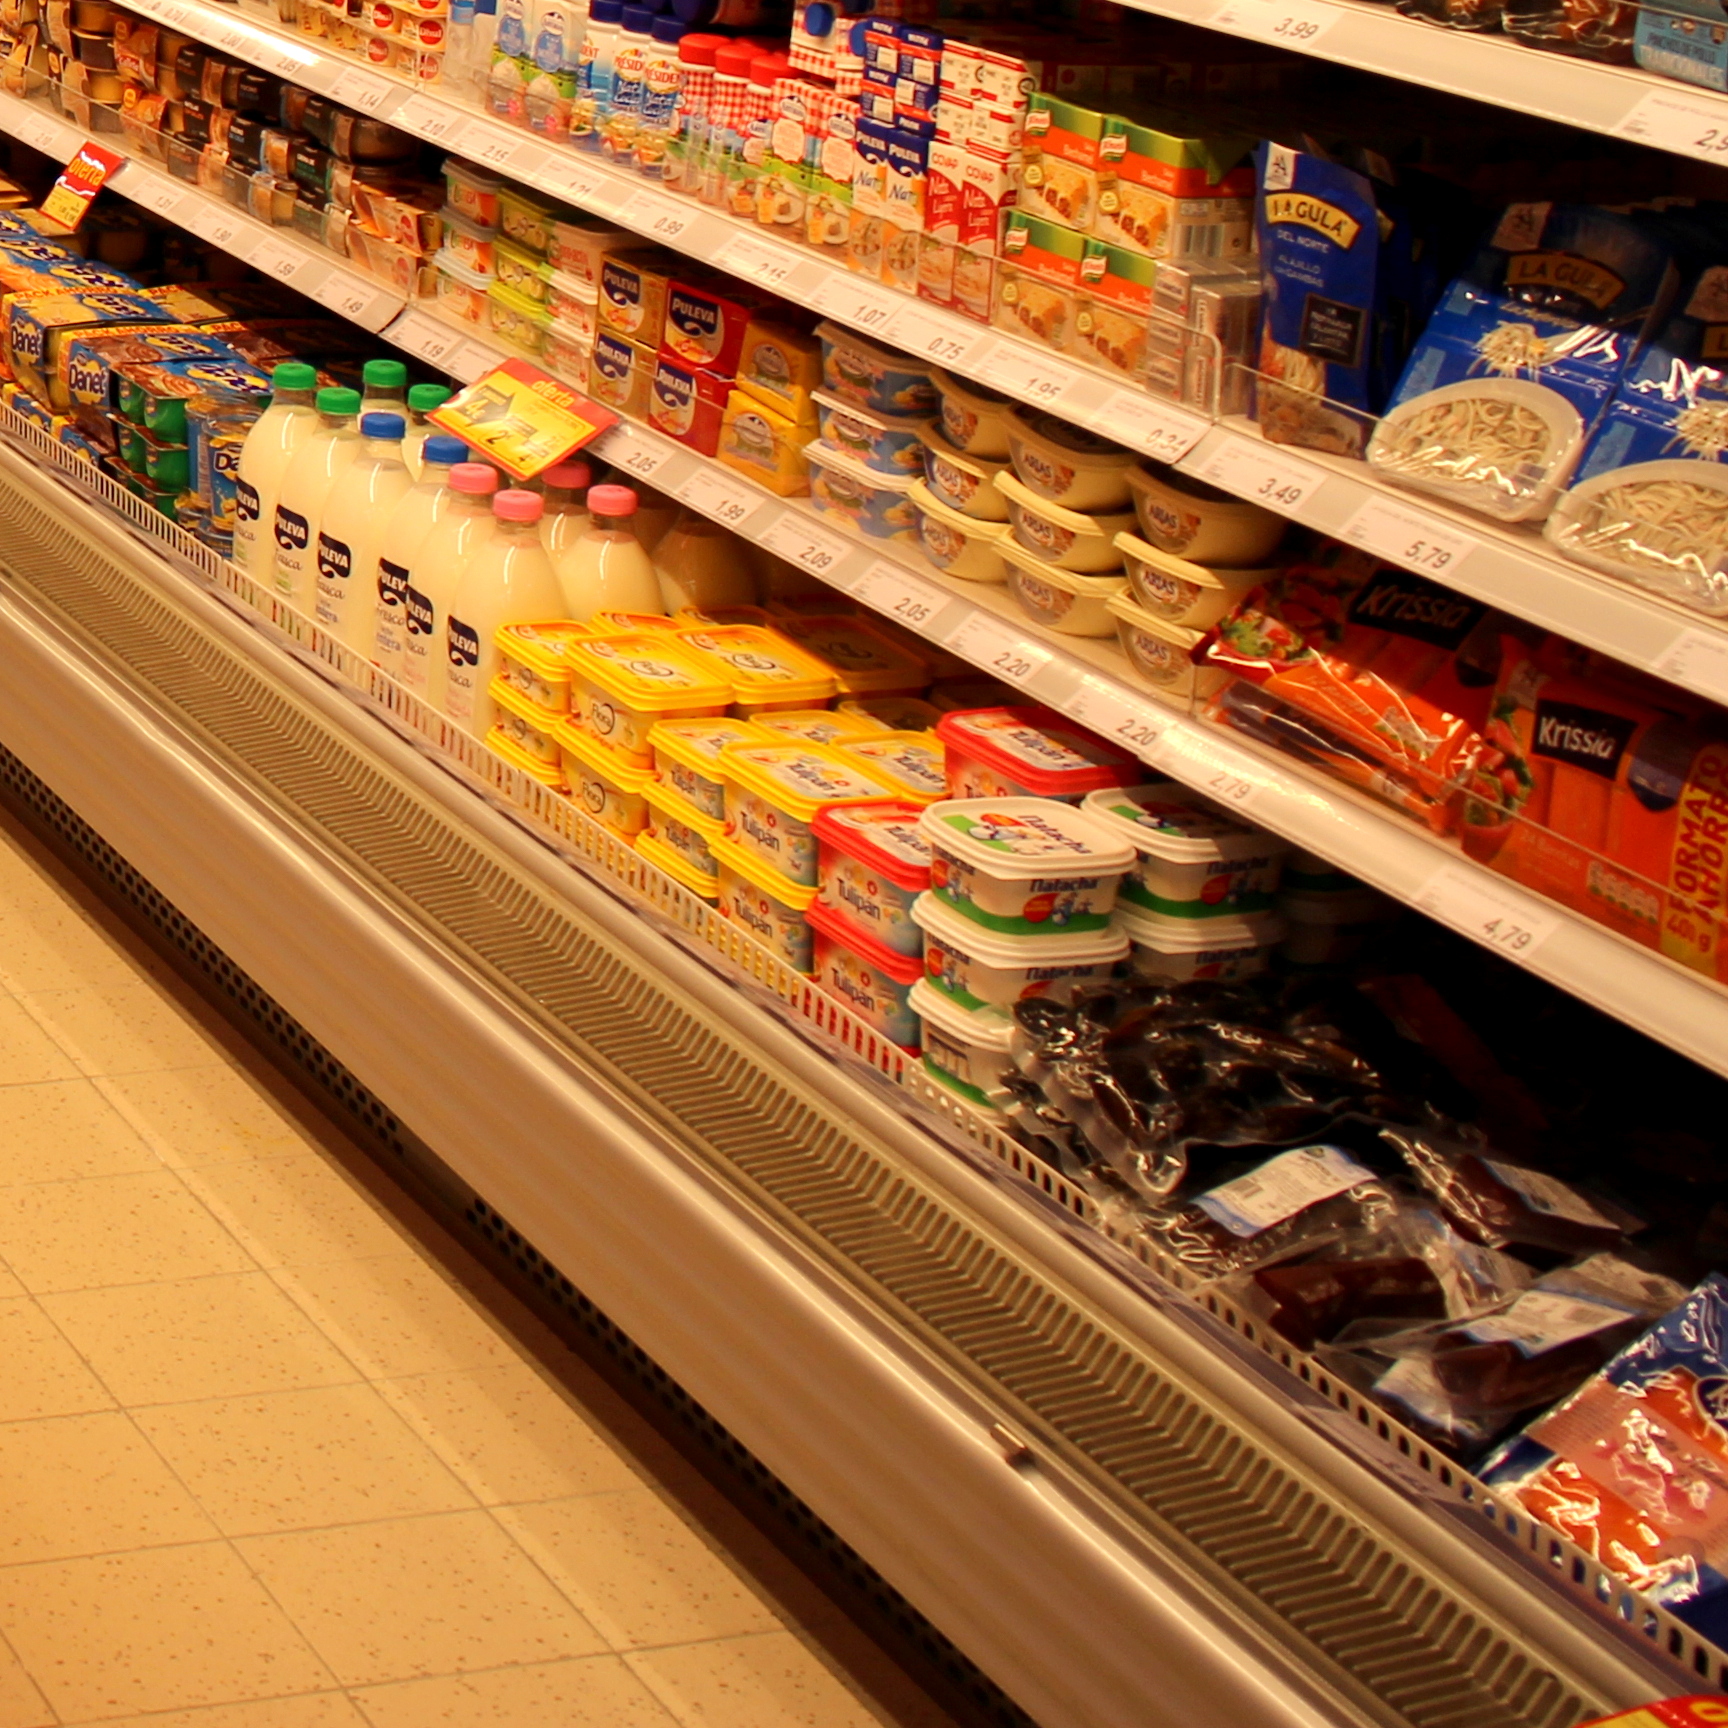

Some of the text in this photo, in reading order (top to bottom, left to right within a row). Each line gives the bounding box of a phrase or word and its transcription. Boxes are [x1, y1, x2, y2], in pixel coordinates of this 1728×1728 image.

[1274, 18, 1319, 39] 3,99
[856, 129, 886, 152] PULEVA
[889, 144, 921, 164] PULEVA
[68, 157, 106, 187] oferta
[1294, 200, 1348, 237] GULA
[274, 260, 296, 276] 1,59
[756, 265, 787, 284] 2,15
[604, 271, 641, 294] PULEVA
[341, 296, 364, 313] 1,49
[672, 297, 716, 326] PULEVA
[851, 304, 887, 326] 1,07
[10, 323, 43, 357] Danet
[421, 340, 446, 358] 1,19
[927, 336, 965, 359] 0,75
[69, 368, 107, 397] Danet
[531, 378, 575, 409] oferta
[1021, 377, 1062, 400] 1,95
[626, 450, 658, 473] 2,05
[1258, 477, 1303, 505] 3,49
[714, 499, 747, 521] 1,99
[798, 545, 834, 570] 2,09
[1404, 540, 1452, 569] 5,79
[893, 596, 933, 622] 2,05
[993, 652, 1032, 677] 2,20
[1116, 719, 1158, 746] 2,20
[1537, 716, 1617, 761] Krissia
[1208, 773, 1252, 800] 2,79
[1019, 815, 1092, 856] Natacha
[1668, 753, 1724, 907] FORMATO
[1028, 876, 1098, 893] Natacha
[1481, 918, 1532, 951] 4,79
